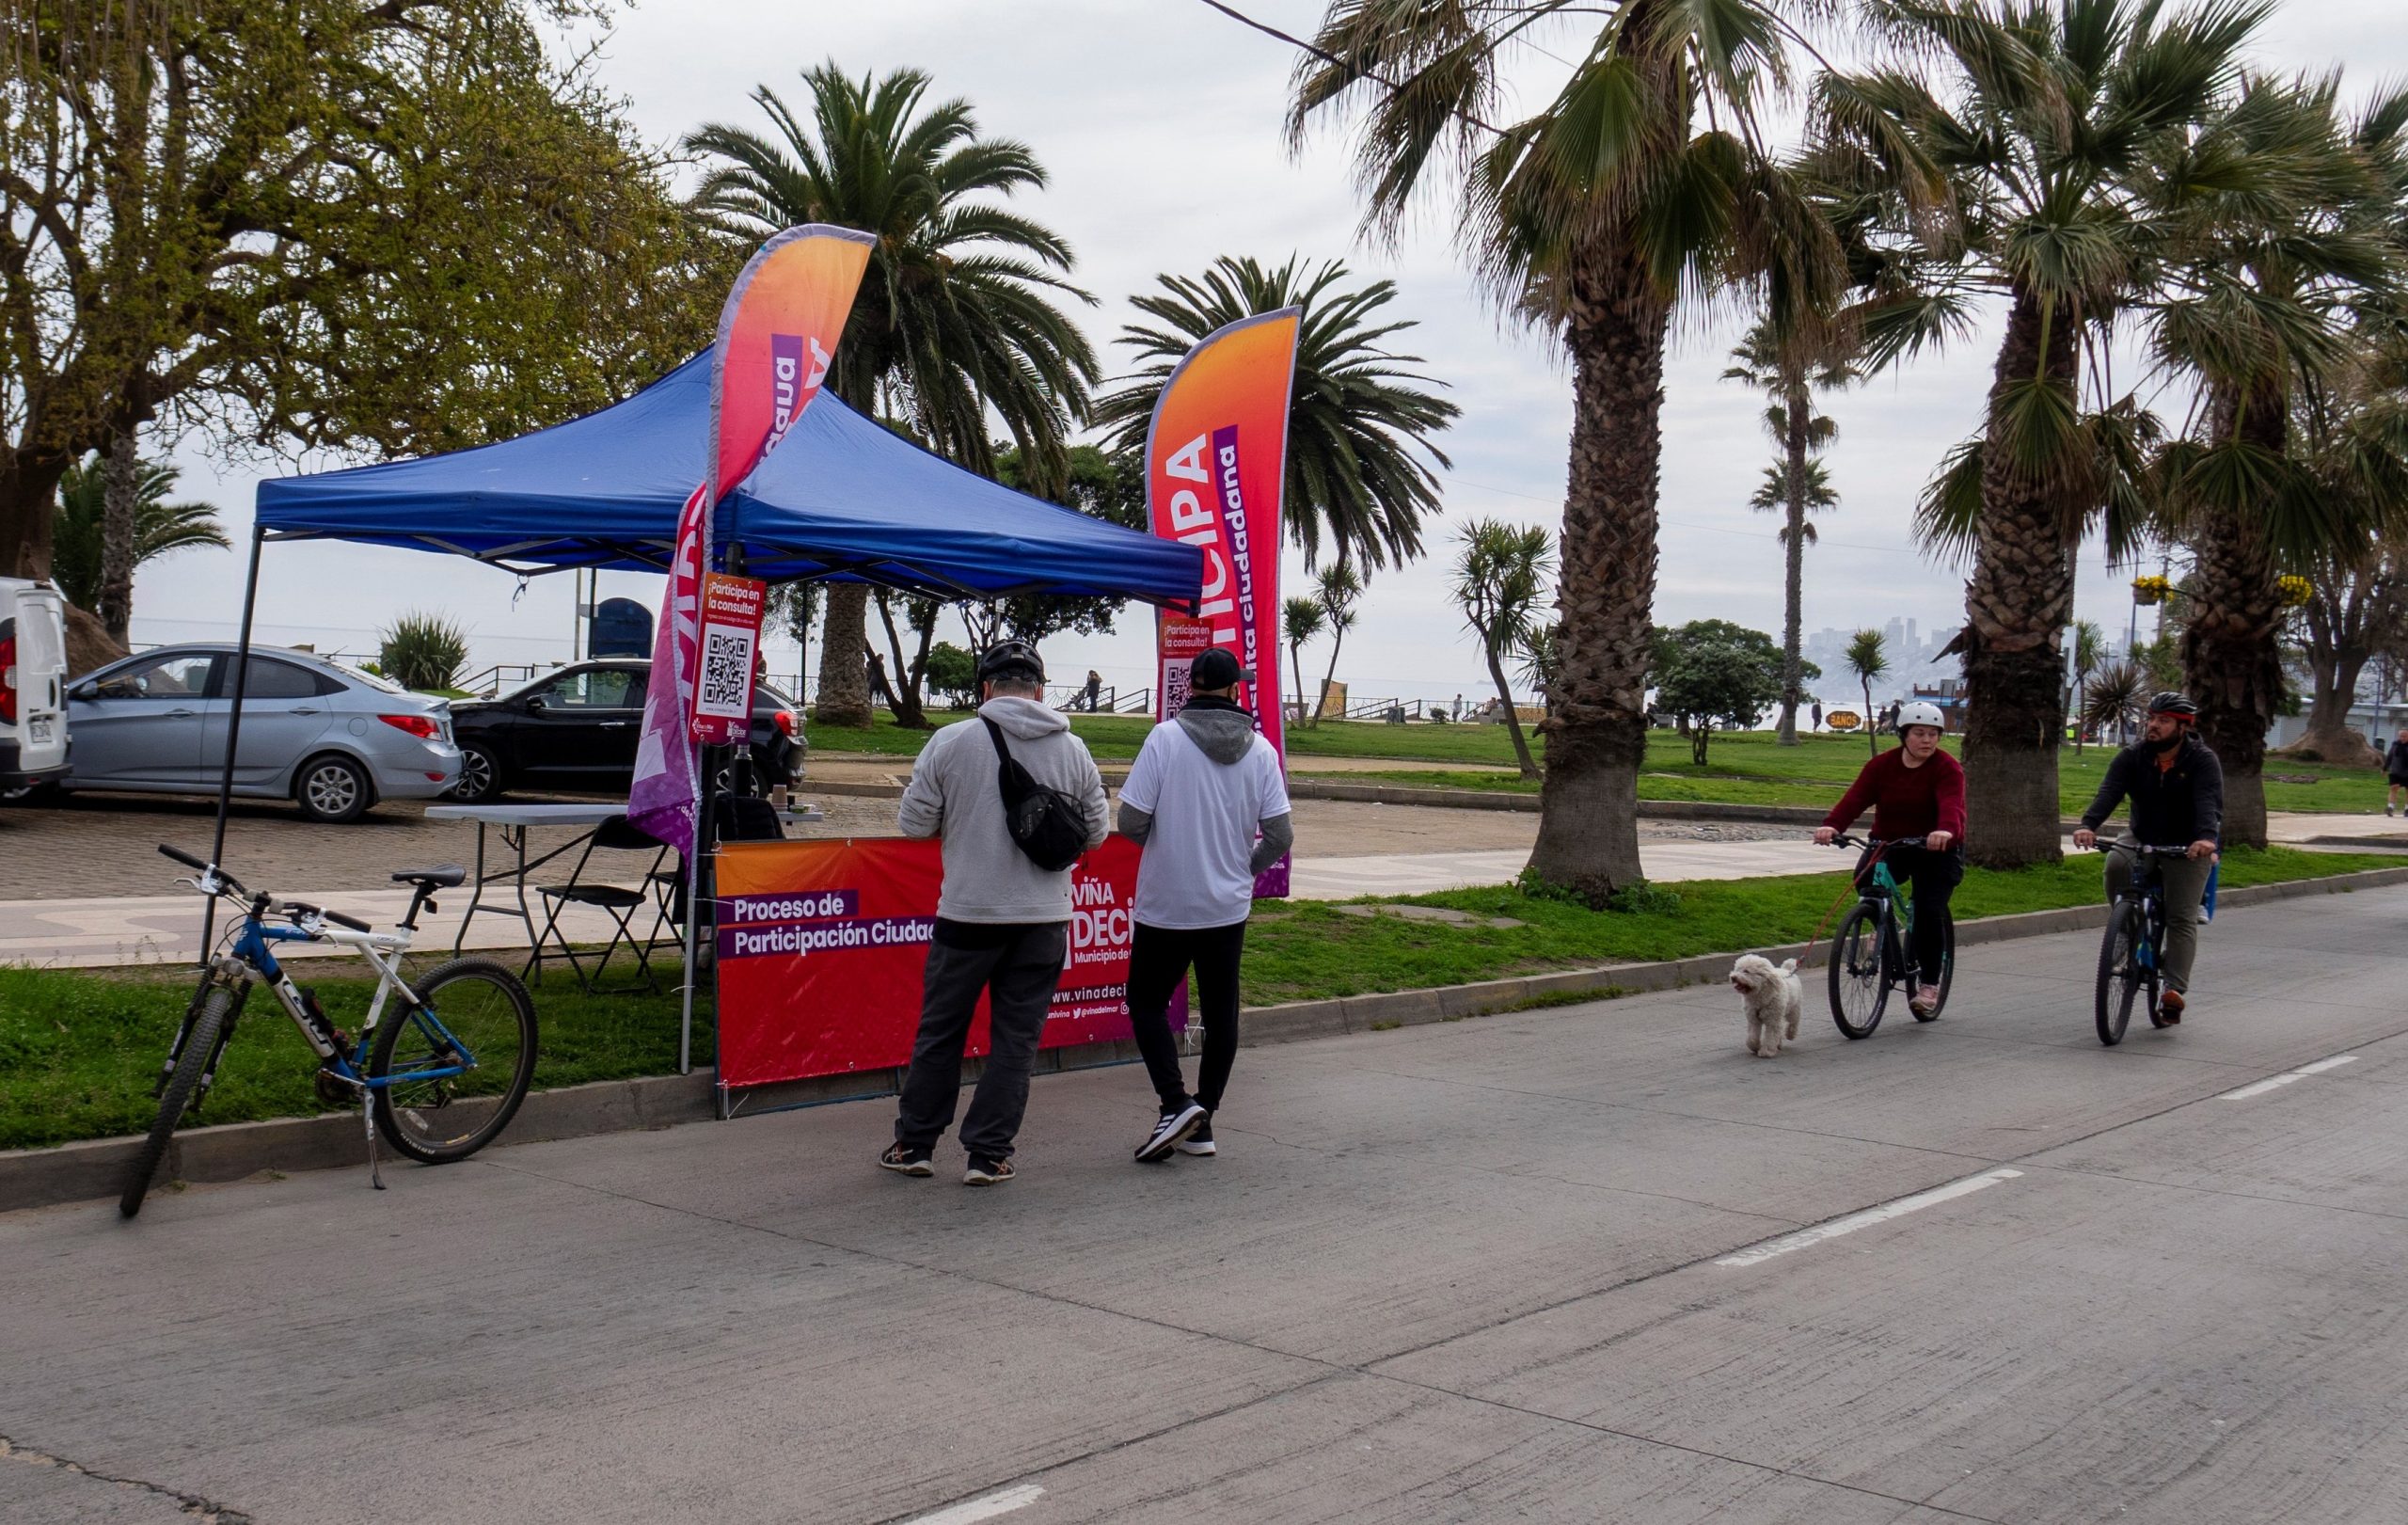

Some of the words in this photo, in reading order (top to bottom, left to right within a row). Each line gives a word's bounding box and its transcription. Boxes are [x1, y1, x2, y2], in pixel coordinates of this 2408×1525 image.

[1219, 444, 1254, 622] ciudadana
[708, 581, 748, 601] ¡Participa
[749, 590, 760, 601] en
[708, 596, 717, 610] la
[717, 599, 756, 615] consulta!
[1164, 637, 1172, 646] la
[1830, 712, 1857, 725] BAÑOS
[734, 898, 816, 922] Proceso
[818, 893, 845, 916] de
[735, 920, 868, 957] Participación
[1074, 949, 1117, 965] Municipio
[1117, 948, 1129, 960] de
[1053, 982, 1127, 1004] ww.vinadeci
